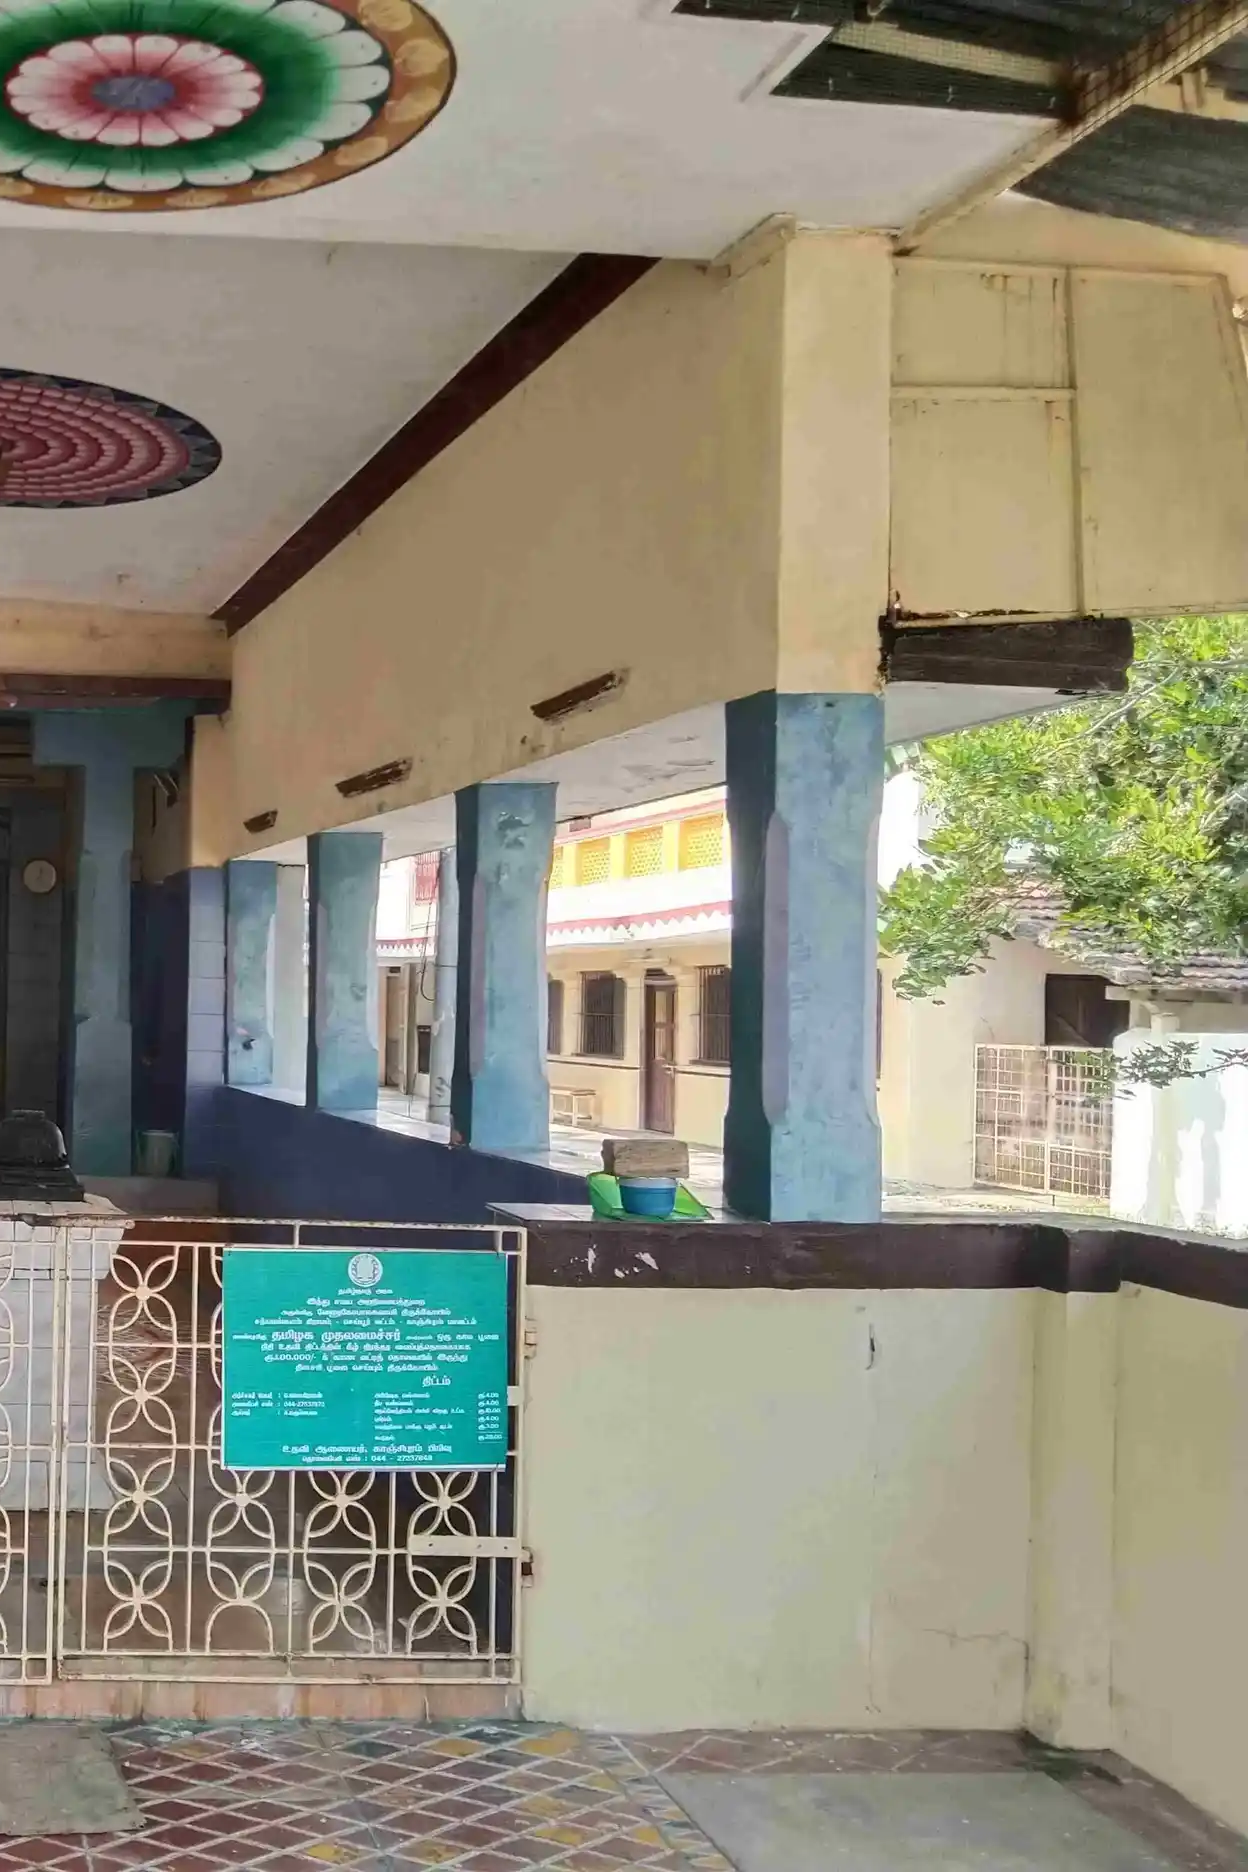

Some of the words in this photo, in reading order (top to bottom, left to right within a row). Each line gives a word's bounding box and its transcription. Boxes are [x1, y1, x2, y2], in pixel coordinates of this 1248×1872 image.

[271, 1329, 314, 1341] தமிழக
[321, 1328, 401, 1342] முதலமைச்சர்
[421, 1374, 451, 1387] திட்டம்
